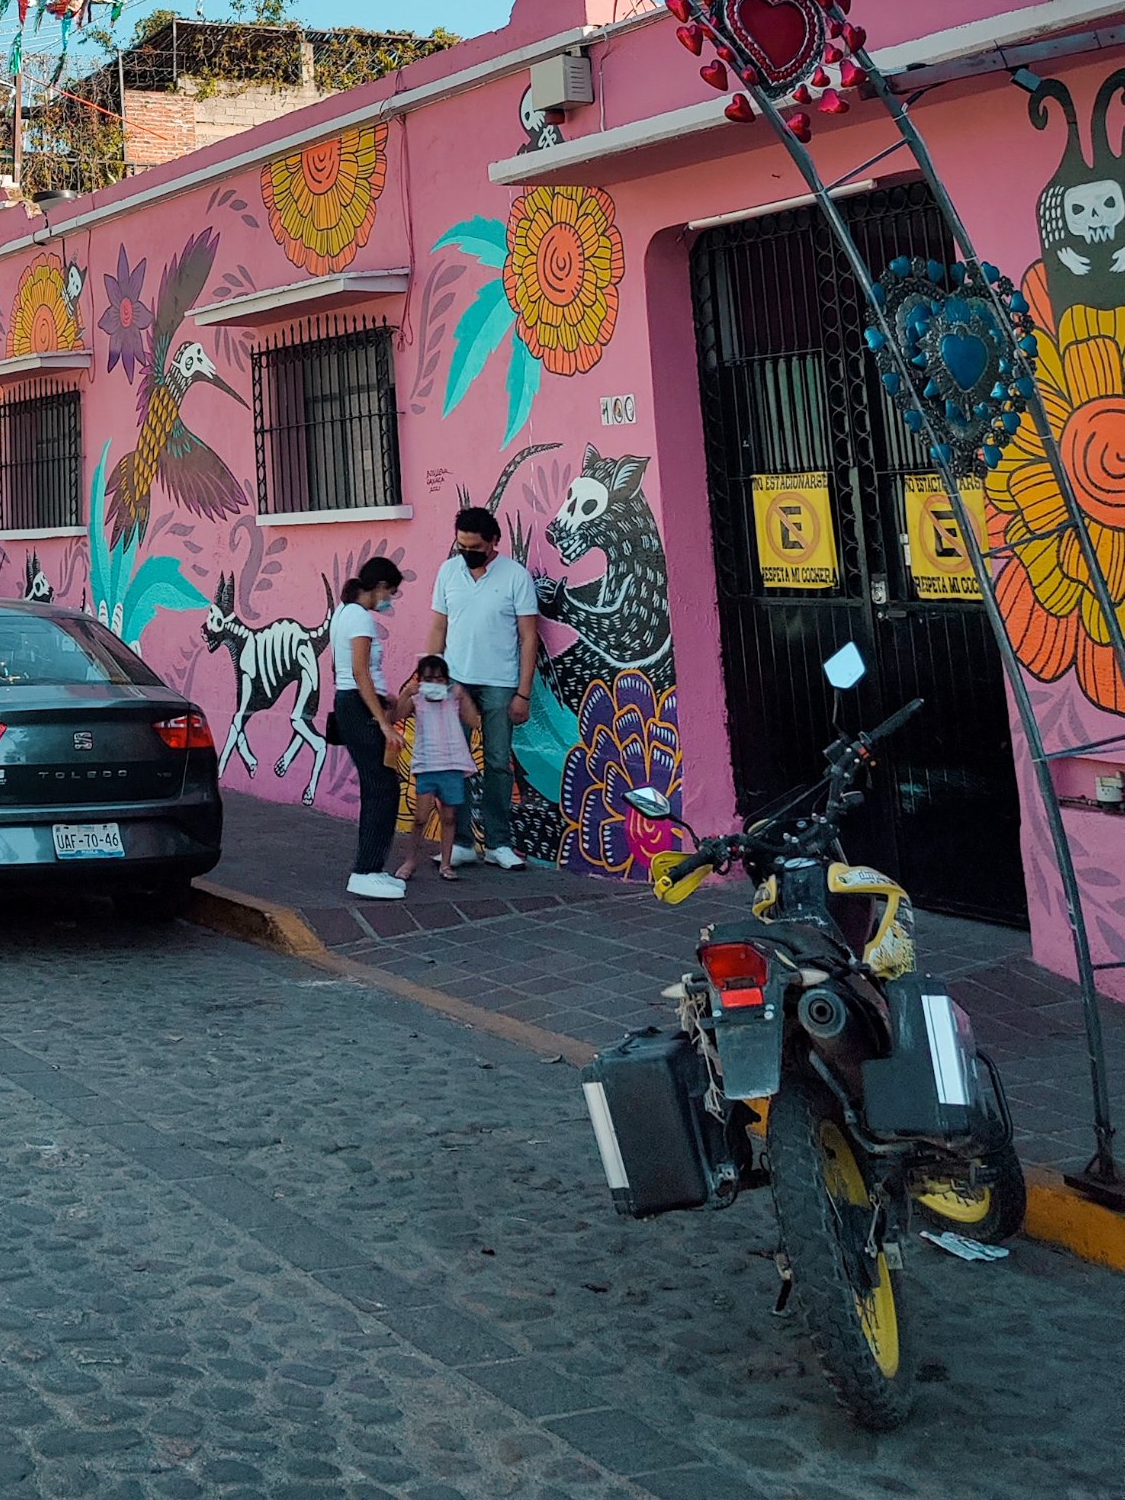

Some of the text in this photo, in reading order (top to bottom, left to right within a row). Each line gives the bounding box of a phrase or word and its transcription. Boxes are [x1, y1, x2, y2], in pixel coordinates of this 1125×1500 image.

[602, 396, 635, 424] 100
[765, 473, 828, 490] ESTACIONARSE
[791, 567, 800, 583] MI
[801, 567, 837, 584] COCHERA
[948, 576, 961, 593] MI
[38, 769, 128, 780] TOLEDO
[56, 832, 119, 850] UAF-70-46
